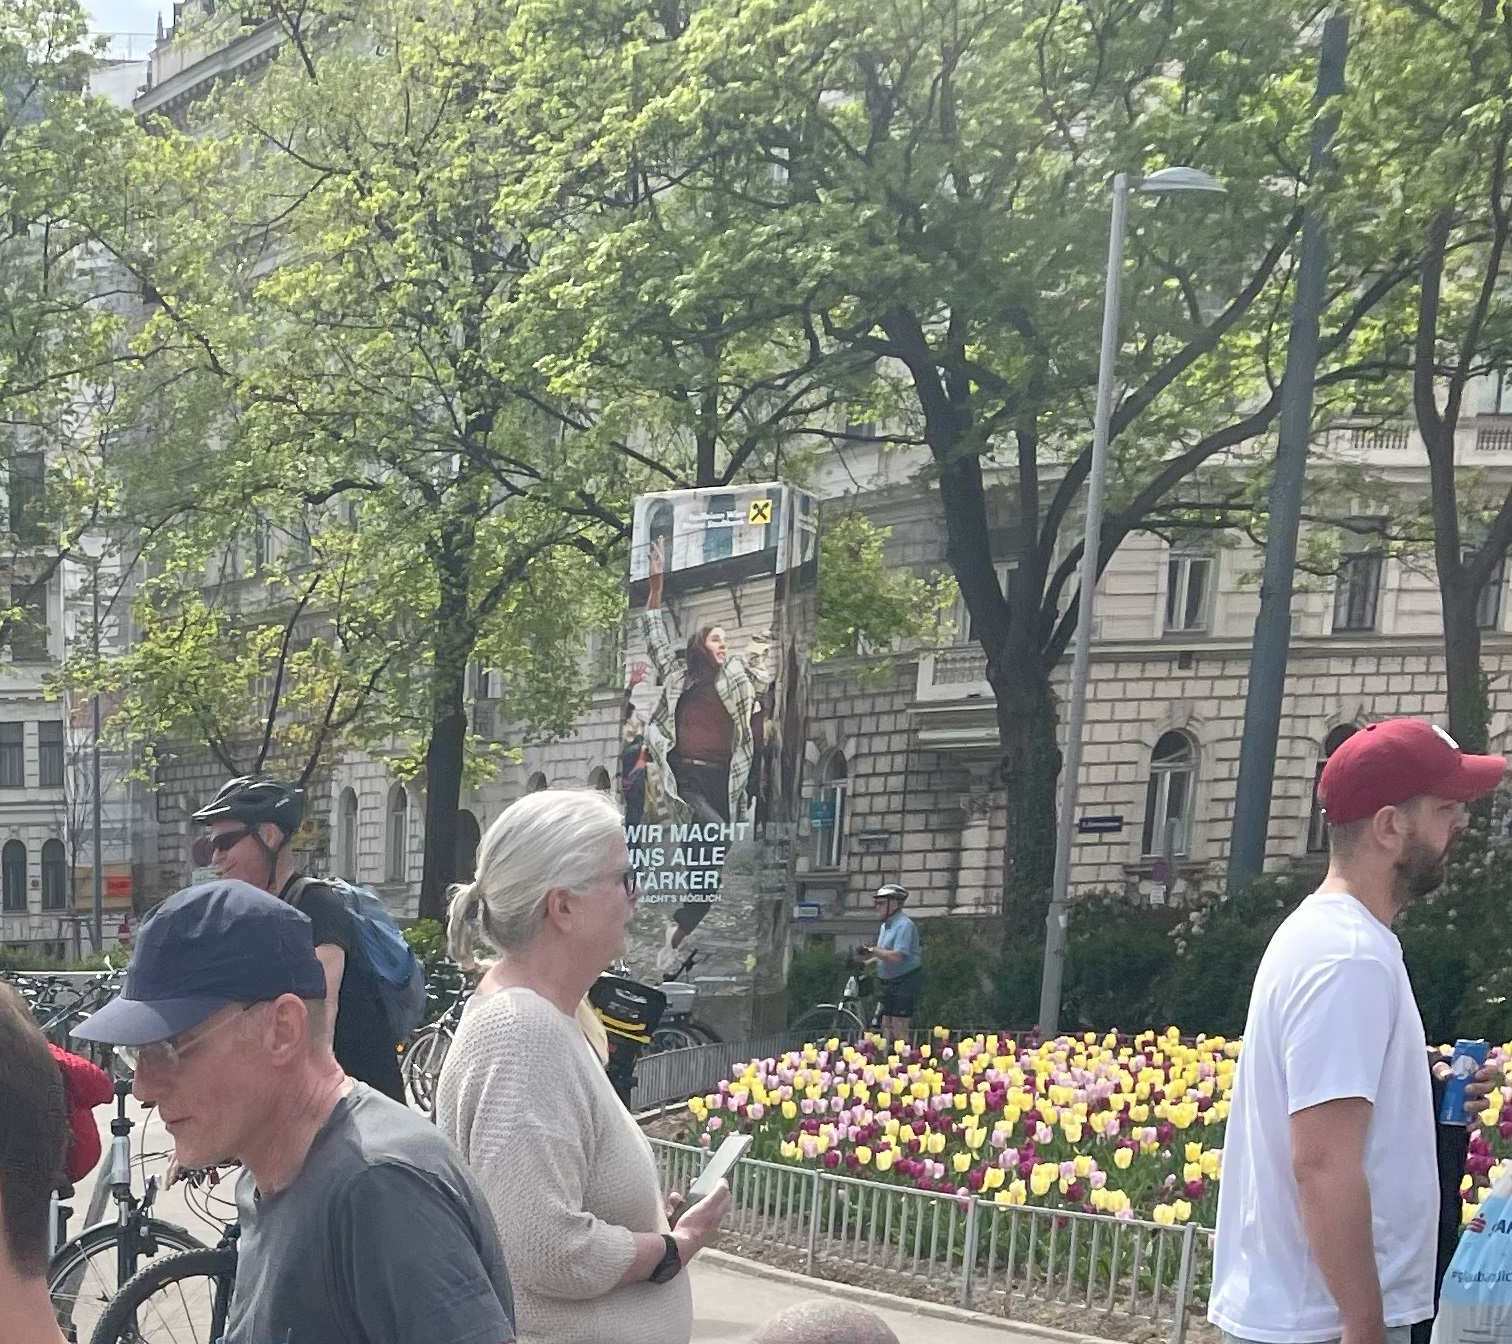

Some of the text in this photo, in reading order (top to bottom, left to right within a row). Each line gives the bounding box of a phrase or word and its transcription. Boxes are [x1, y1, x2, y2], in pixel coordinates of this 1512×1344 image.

[624, 823, 749, 844] WIR MACHT
[671, 847, 725, 866] ALLE
[636, 867, 724, 890] TÄRKER.
